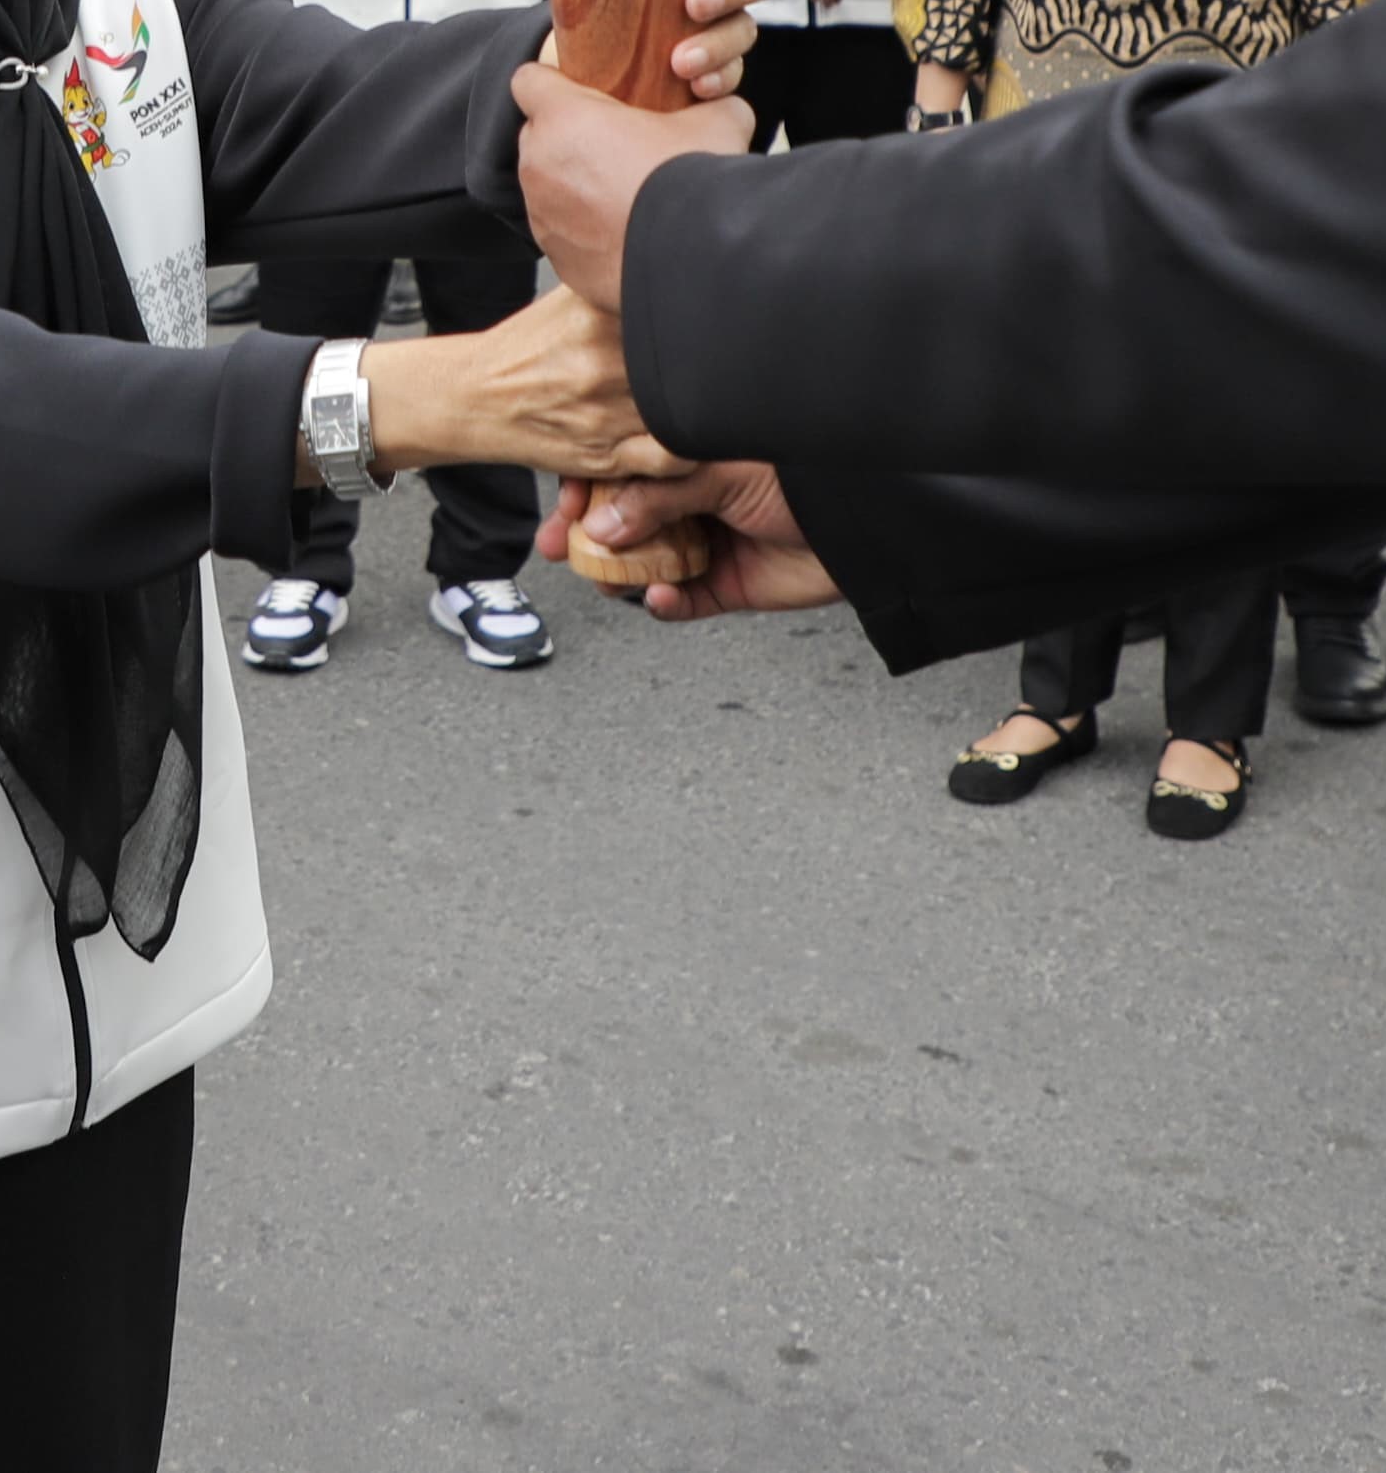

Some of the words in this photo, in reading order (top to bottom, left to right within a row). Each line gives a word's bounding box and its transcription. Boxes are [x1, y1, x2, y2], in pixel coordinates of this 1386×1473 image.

[129, 97, 161, 124] PON
[159, 77, 187, 103] XXI
[140, 96, 193, 139] ACEH-SUMUT
[160, 118, 183, 139] 2024
